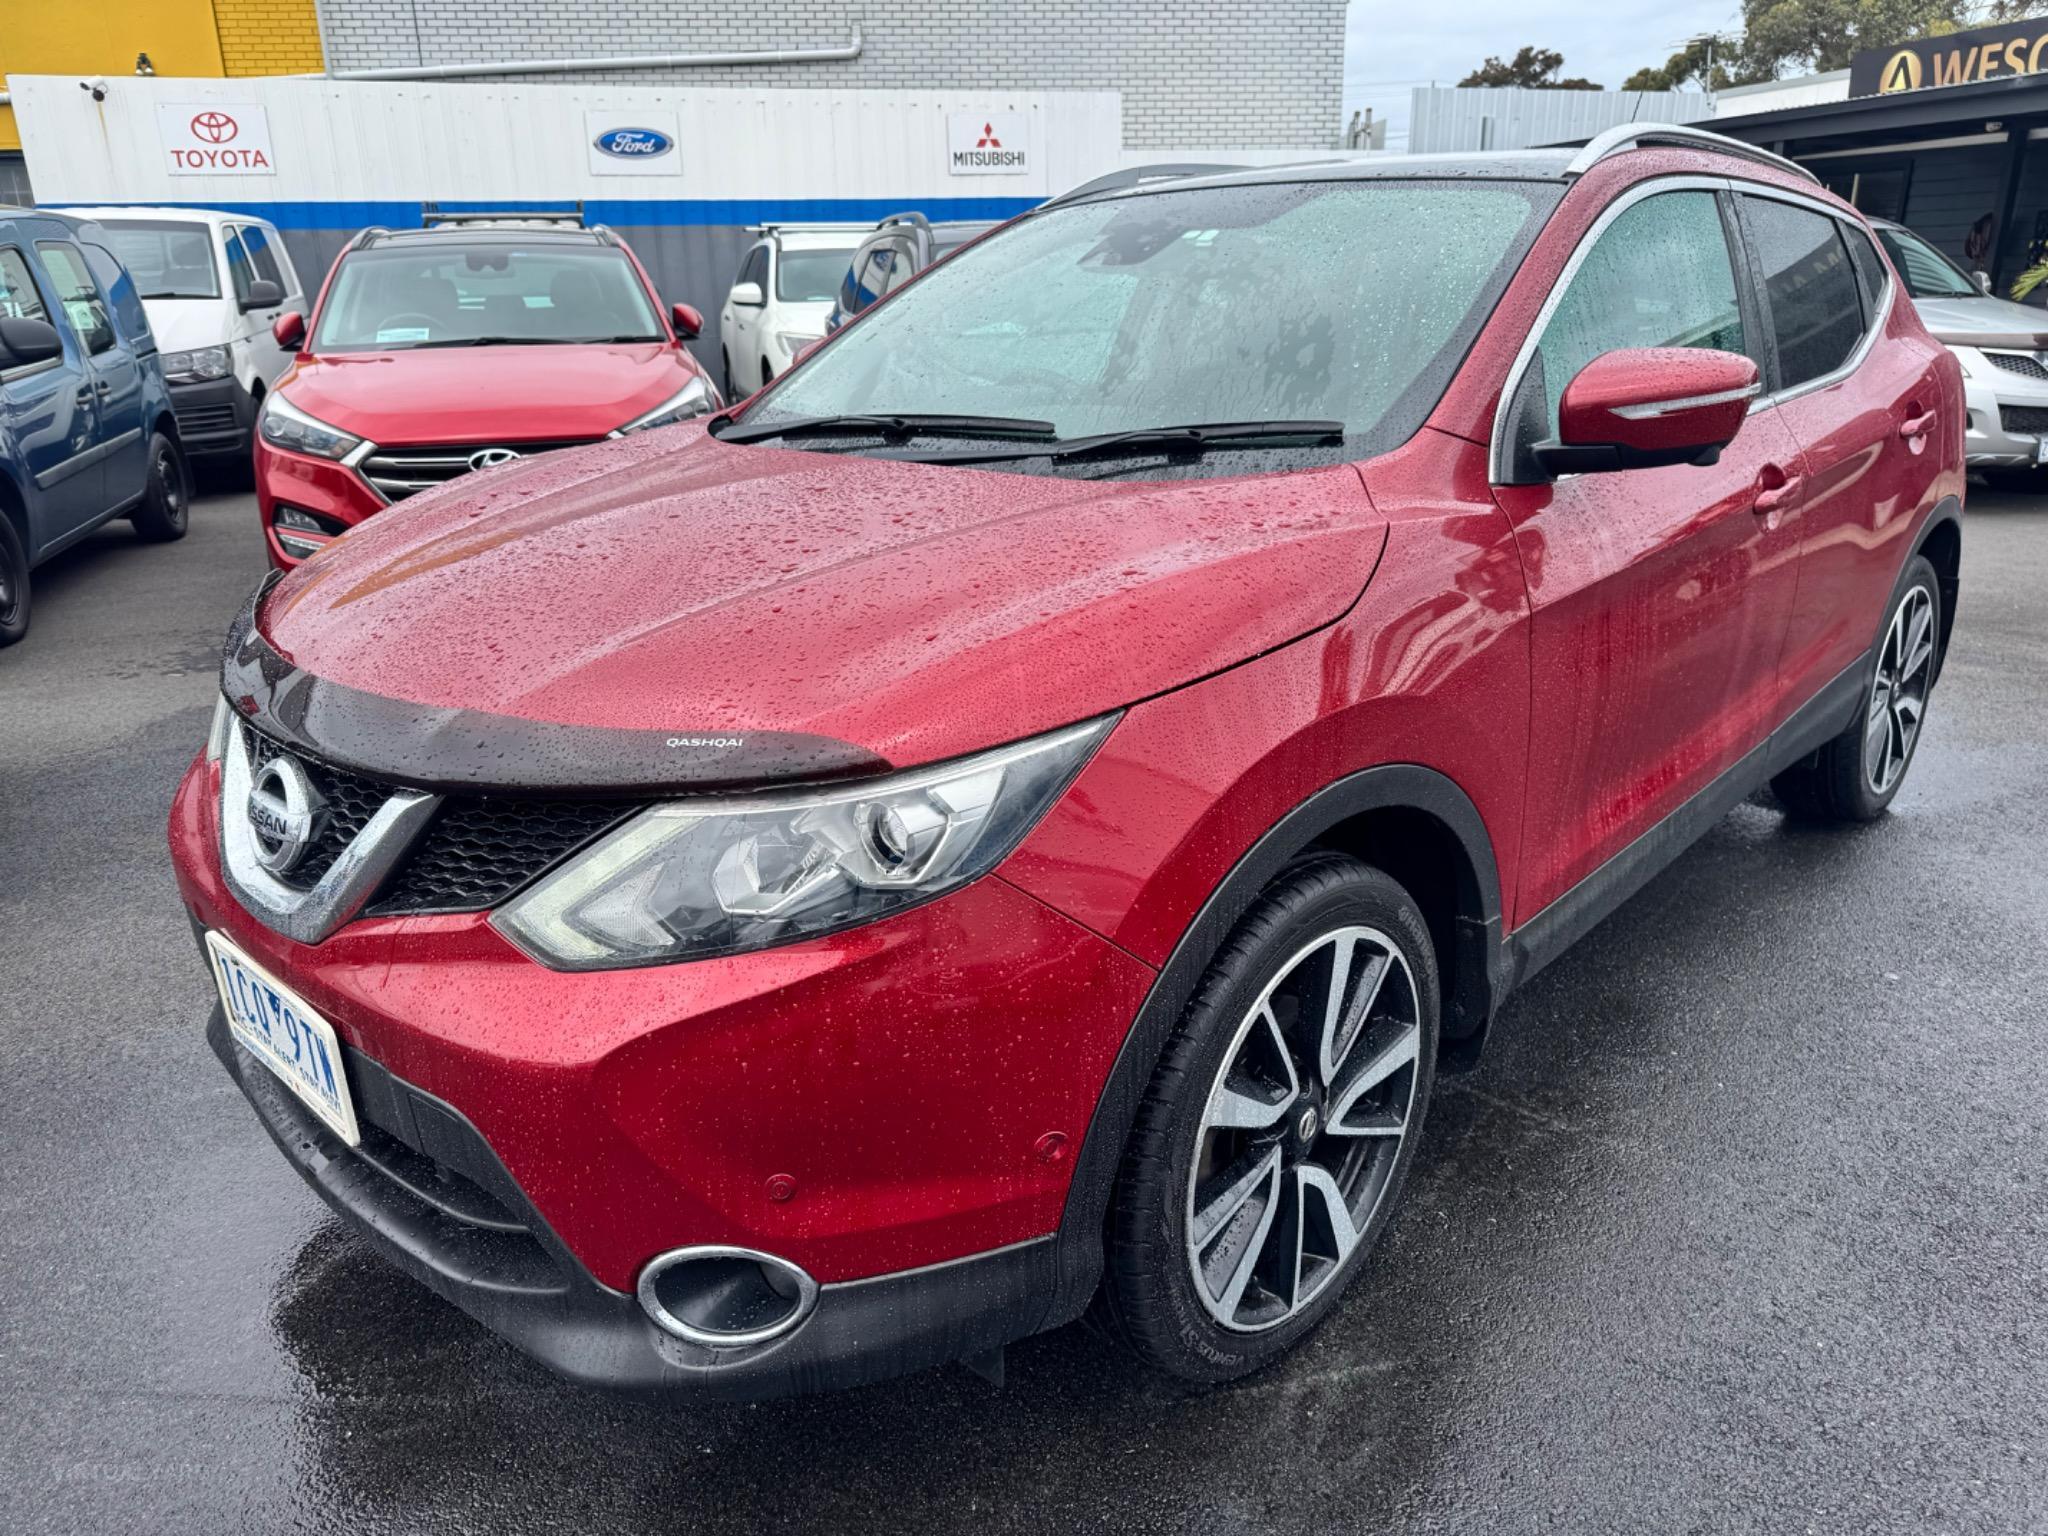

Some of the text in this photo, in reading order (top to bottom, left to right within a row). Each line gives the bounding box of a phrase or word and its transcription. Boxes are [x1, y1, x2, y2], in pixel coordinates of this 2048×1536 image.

[611, 132, 656, 153] Ford
[170, 149, 270, 168] TOYOTA
[952, 151, 1025, 167] MITSUBISHI
[666, 738, 744, 748] QASHQAI
[283, 1007, 339, 1100] 9TW
